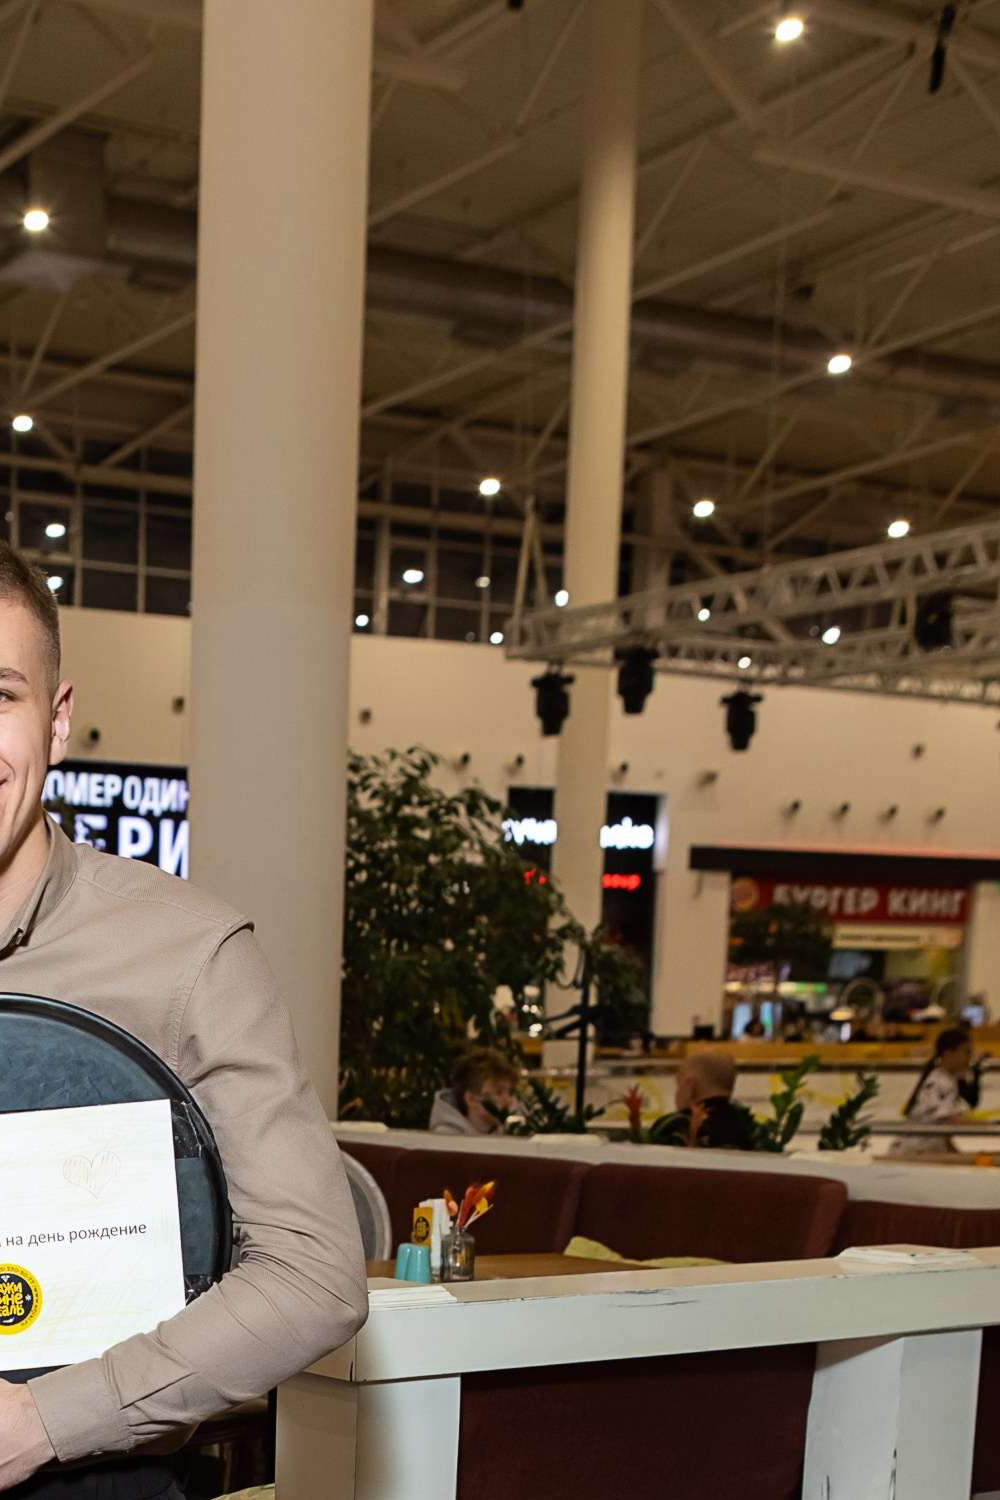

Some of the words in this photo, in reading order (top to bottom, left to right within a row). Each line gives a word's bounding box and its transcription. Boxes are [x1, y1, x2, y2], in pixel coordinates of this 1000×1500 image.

[41, 770, 122, 807] ОМЕР
[48, 812, 190, 880] ЕРИ
[888, 887, 967, 917] КИНГ
[6, 1236, 24, 1247] на
[27, 1232, 65, 1248] день
[69, 1223, 148, 1243] рождение
